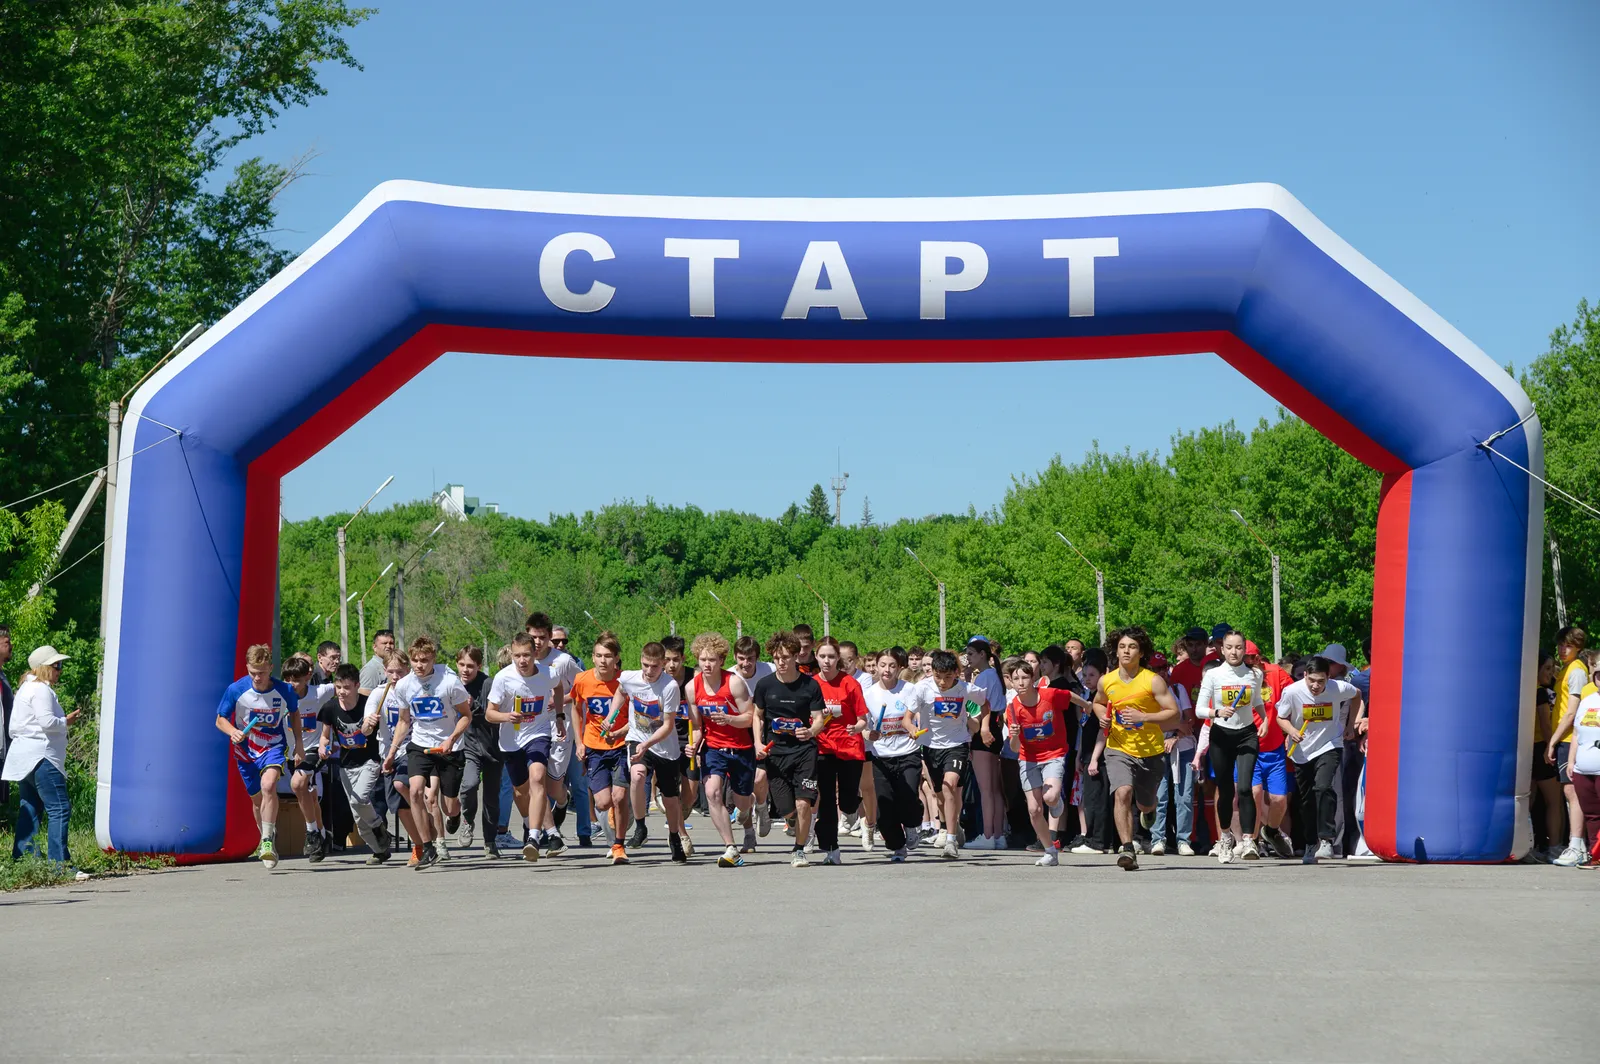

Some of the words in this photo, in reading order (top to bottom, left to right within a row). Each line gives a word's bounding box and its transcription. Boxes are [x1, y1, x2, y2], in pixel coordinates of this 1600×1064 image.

[539, 231, 1120, 321] СТАРТ
[592, 698, 612, 714] 31
[941, 702, 958, 713] 32
[256, 713, 274, 723] 30
[779, 721, 796, 730] 23
[1034, 727, 1045, 737] 2
[345, 737, 355, 746] 8
[952, 759, 963, 770] 11
